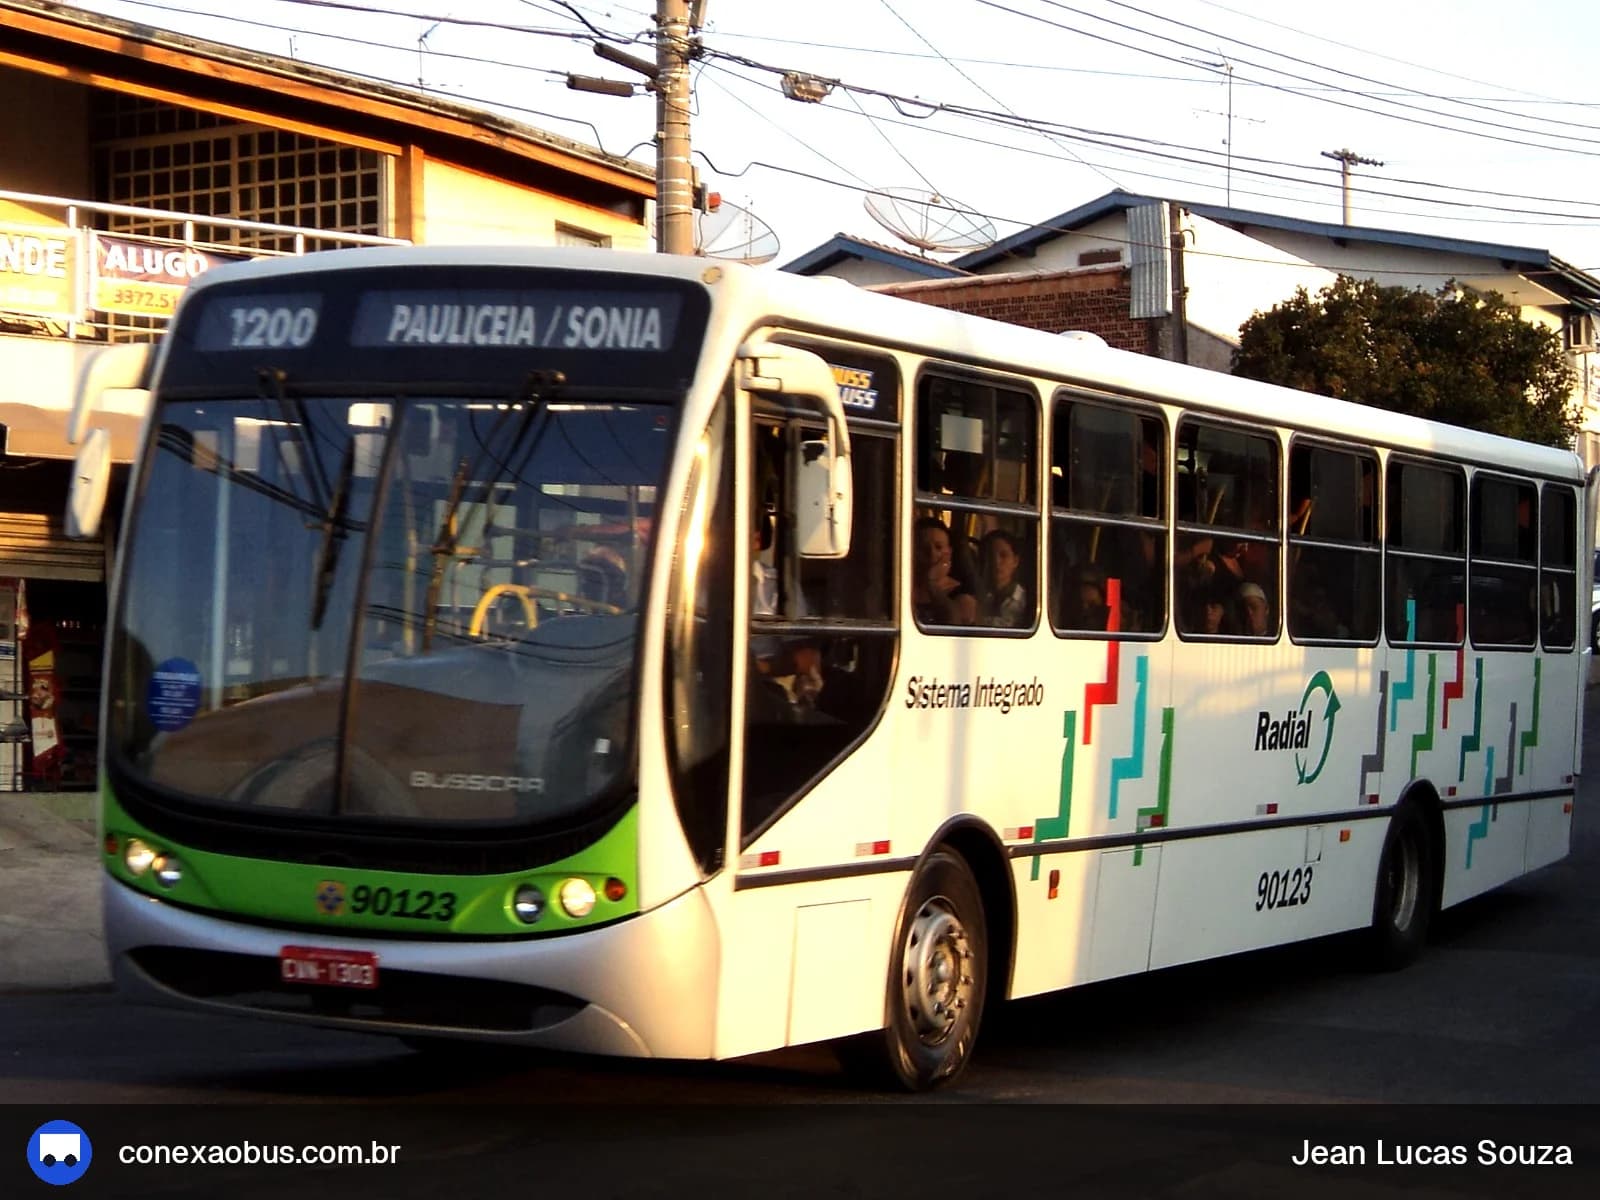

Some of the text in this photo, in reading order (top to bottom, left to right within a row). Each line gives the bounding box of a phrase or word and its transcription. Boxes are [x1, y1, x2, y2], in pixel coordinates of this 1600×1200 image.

[105, 245, 209, 278] ALUGO
[230, 306, 318, 347] 1200
[387, 304, 535, 347] PAULICEIA
[566, 305, 662, 350] SONIA
[905, 675, 1044, 714] Sistema Integrado
[1254, 710, 1313, 751] Radial
[409, 770, 545, 795] BUSSCAR
[351, 884, 458, 922] 90123
[1256, 866, 1313, 912] 90123
